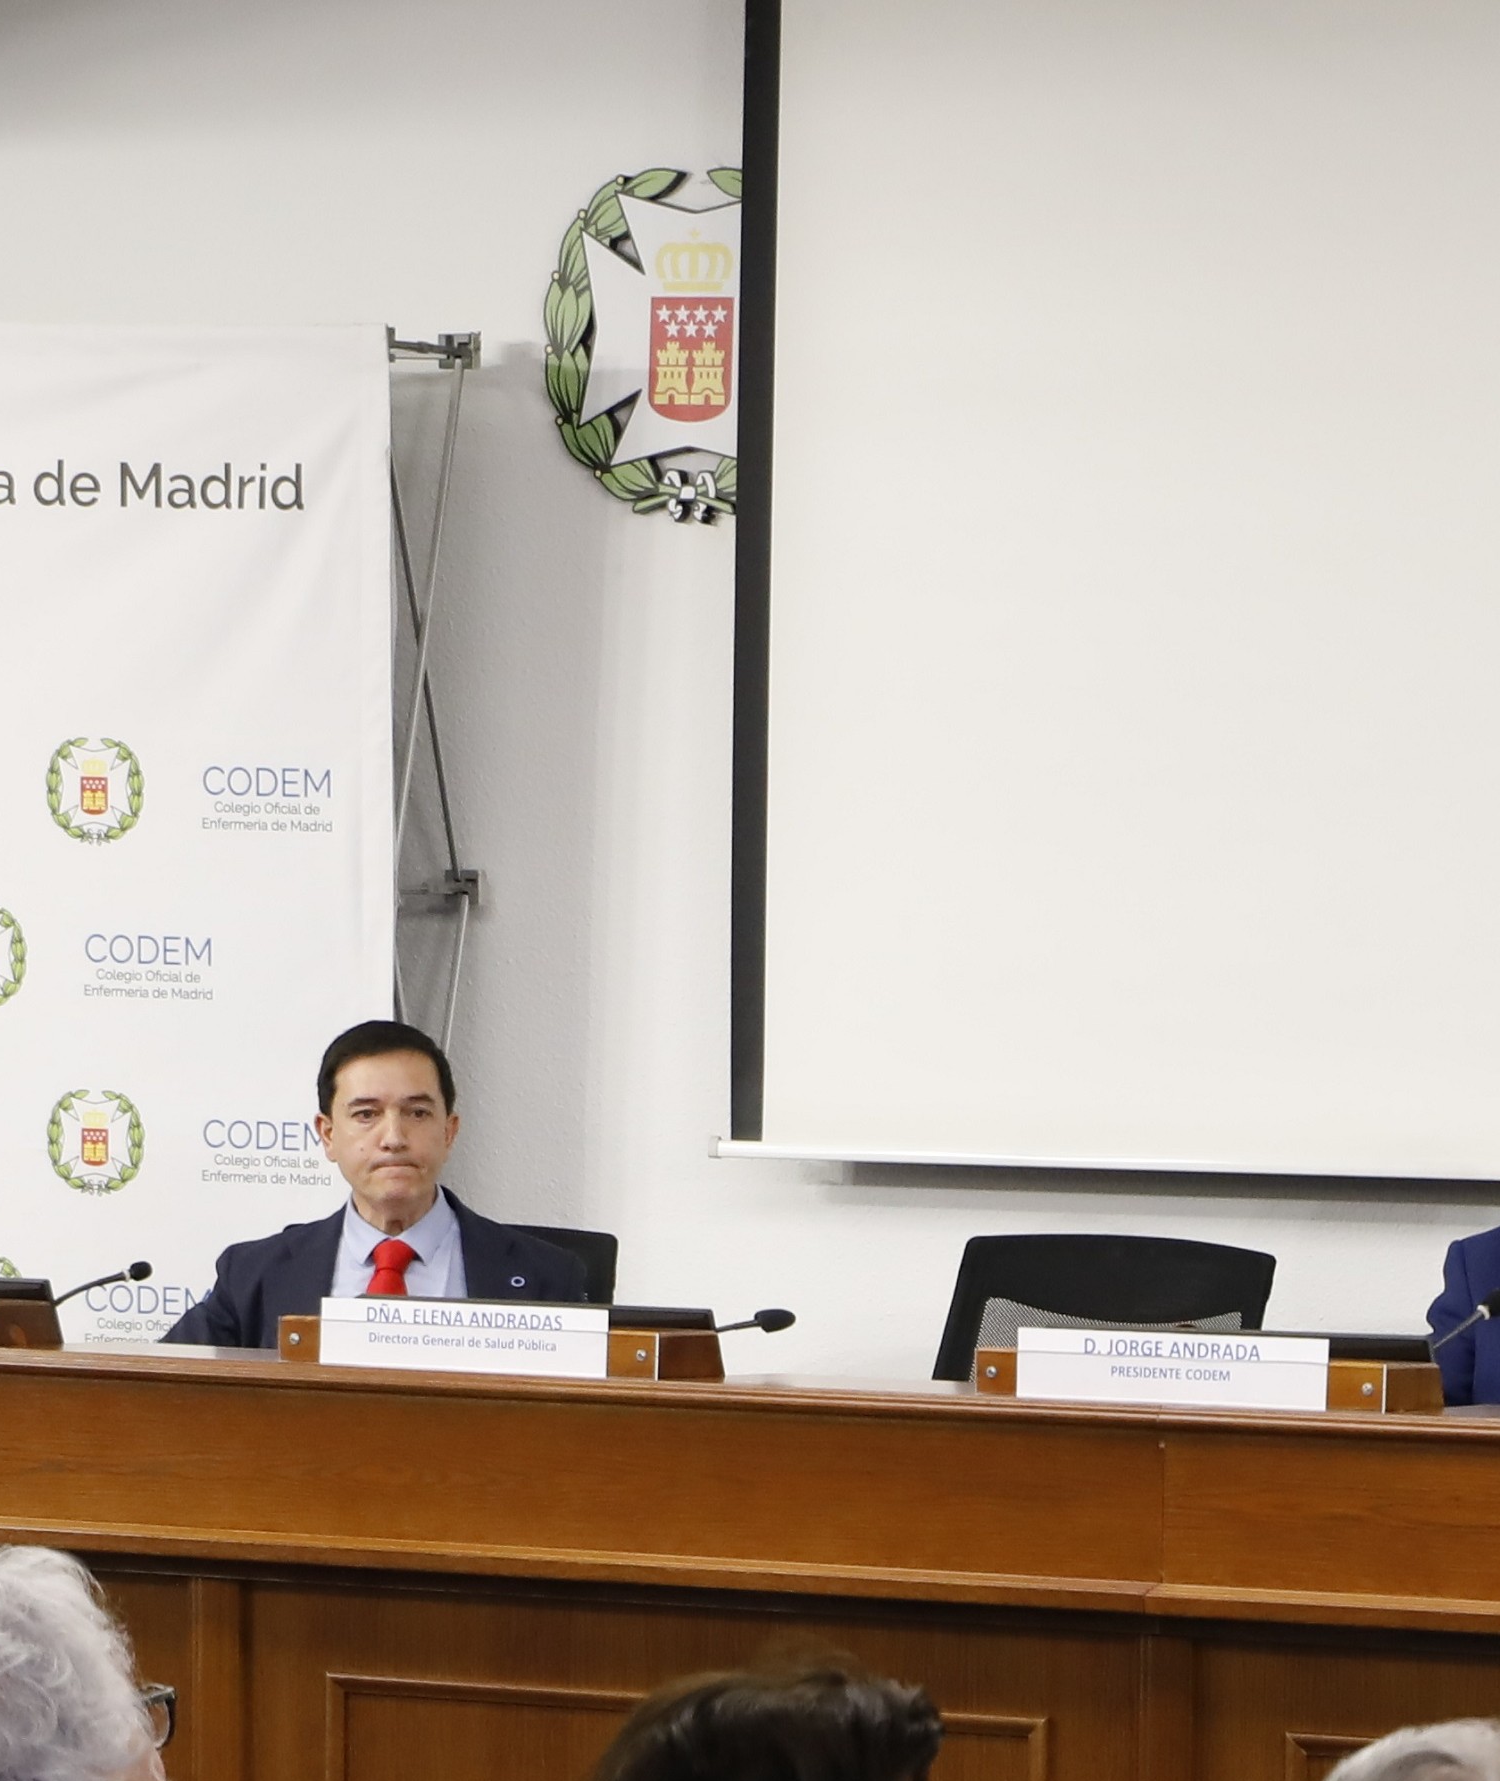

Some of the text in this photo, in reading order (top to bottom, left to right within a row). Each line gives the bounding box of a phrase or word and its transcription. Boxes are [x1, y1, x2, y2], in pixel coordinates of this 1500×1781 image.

[33, 459, 102, 507] de
[120, 461, 305, 511] Madrid
[203, 766, 331, 798] CODEM
[214, 801, 321, 817] Colegio Oficial de
[271, 820, 287, 832] de
[291, 820, 333, 833] Madrid
[85, 934, 211, 966] CODEM
[96, 969, 201, 985] Colegio Oficial de
[152, 988, 168, 1000] de
[171, 988, 213, 1001] Madrid
[214, 1153, 319, 1169] Colegio Oficial de
[270, 1173, 287, 1185] de
[290, 1172, 332, 1186] Madrid
[97, 1318, 143, 1333] Colegio
[365, 1303, 563, 1331] DÑA. ELENA ANDRADAS
[368, 1331, 419, 1346] Directora
[422, 1334, 465, 1348] General
[468, 1336, 481, 1349] de
[484, 1337, 515, 1351] Salud
[1083, 1338, 1261, 1362] D. JORGE ANDRADA
[1110, 1365, 1231, 1383] PRESIDENTE CODEM
